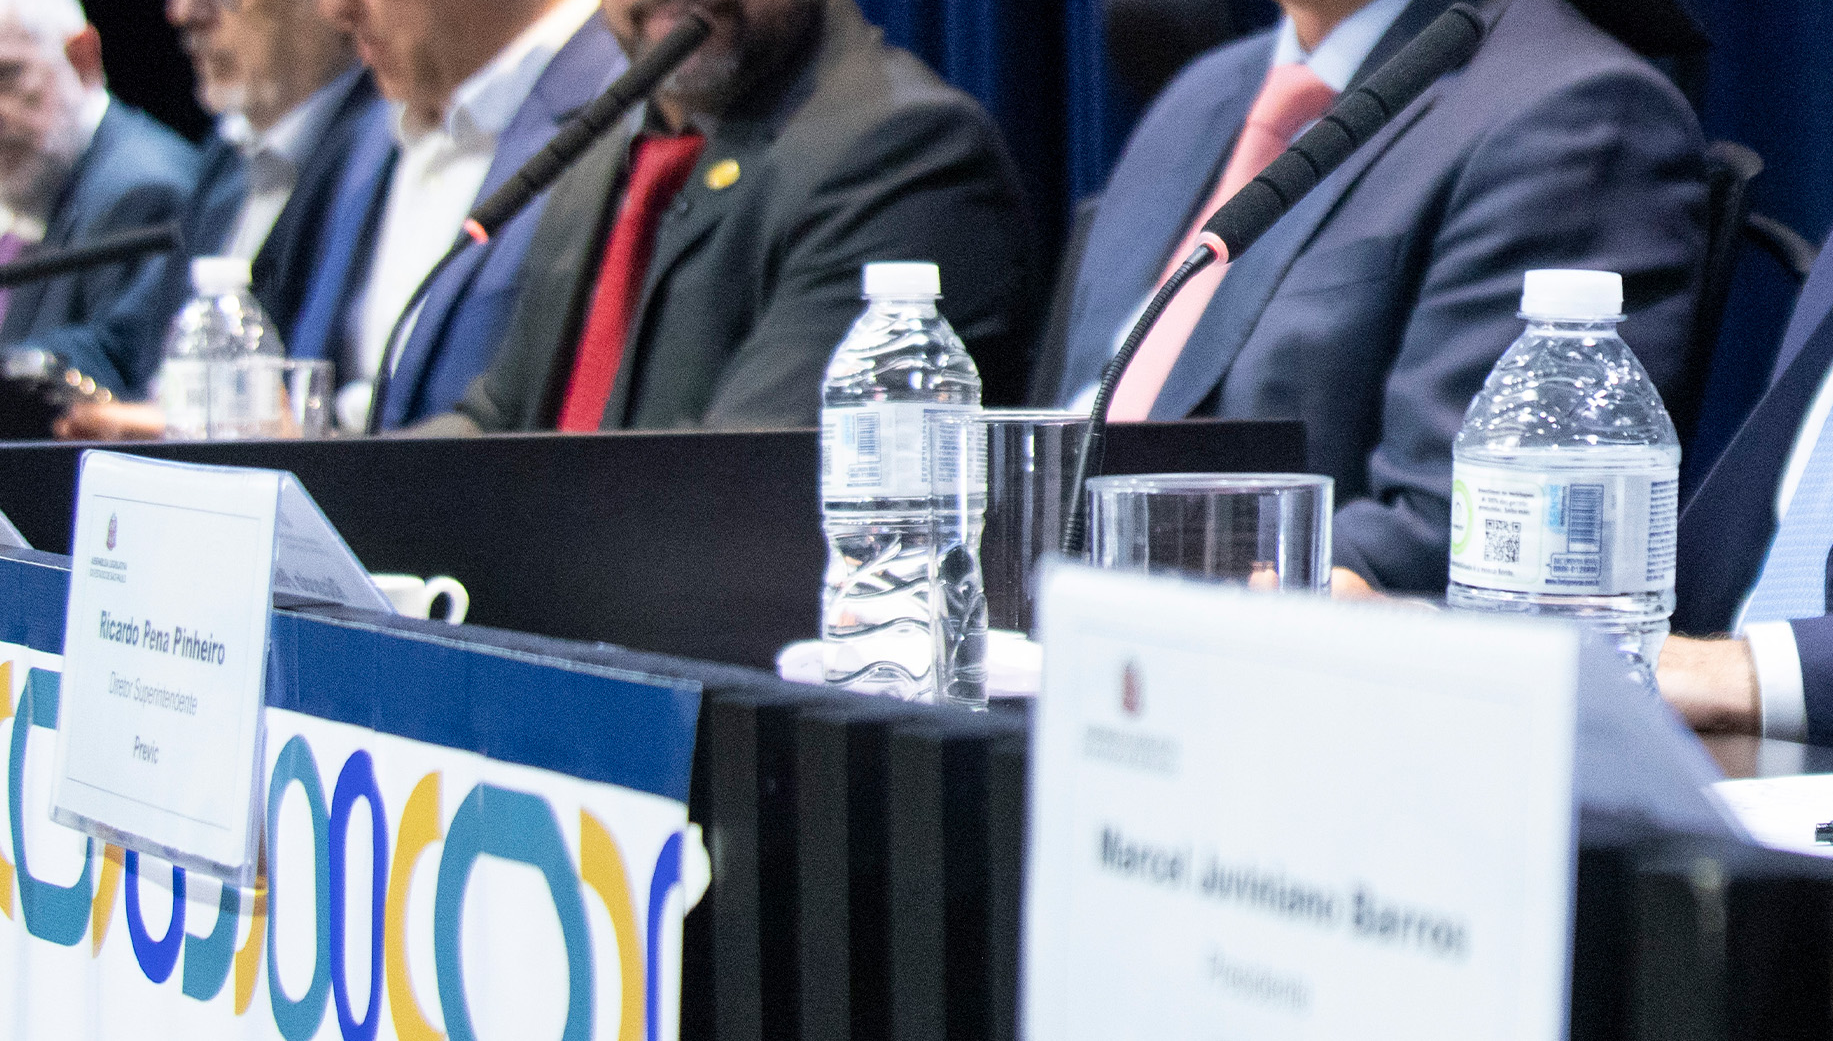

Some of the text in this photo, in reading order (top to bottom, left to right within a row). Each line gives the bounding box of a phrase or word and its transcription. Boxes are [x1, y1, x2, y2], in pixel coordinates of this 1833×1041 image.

[100, 609, 226, 665] Ricardo Pena Pinheiro
[109, 670, 198, 716] Diretor Superintendente
[133, 735, 159, 764] Previc
[1099, 823, 1469, 960] Marcel Juviniano Barros
